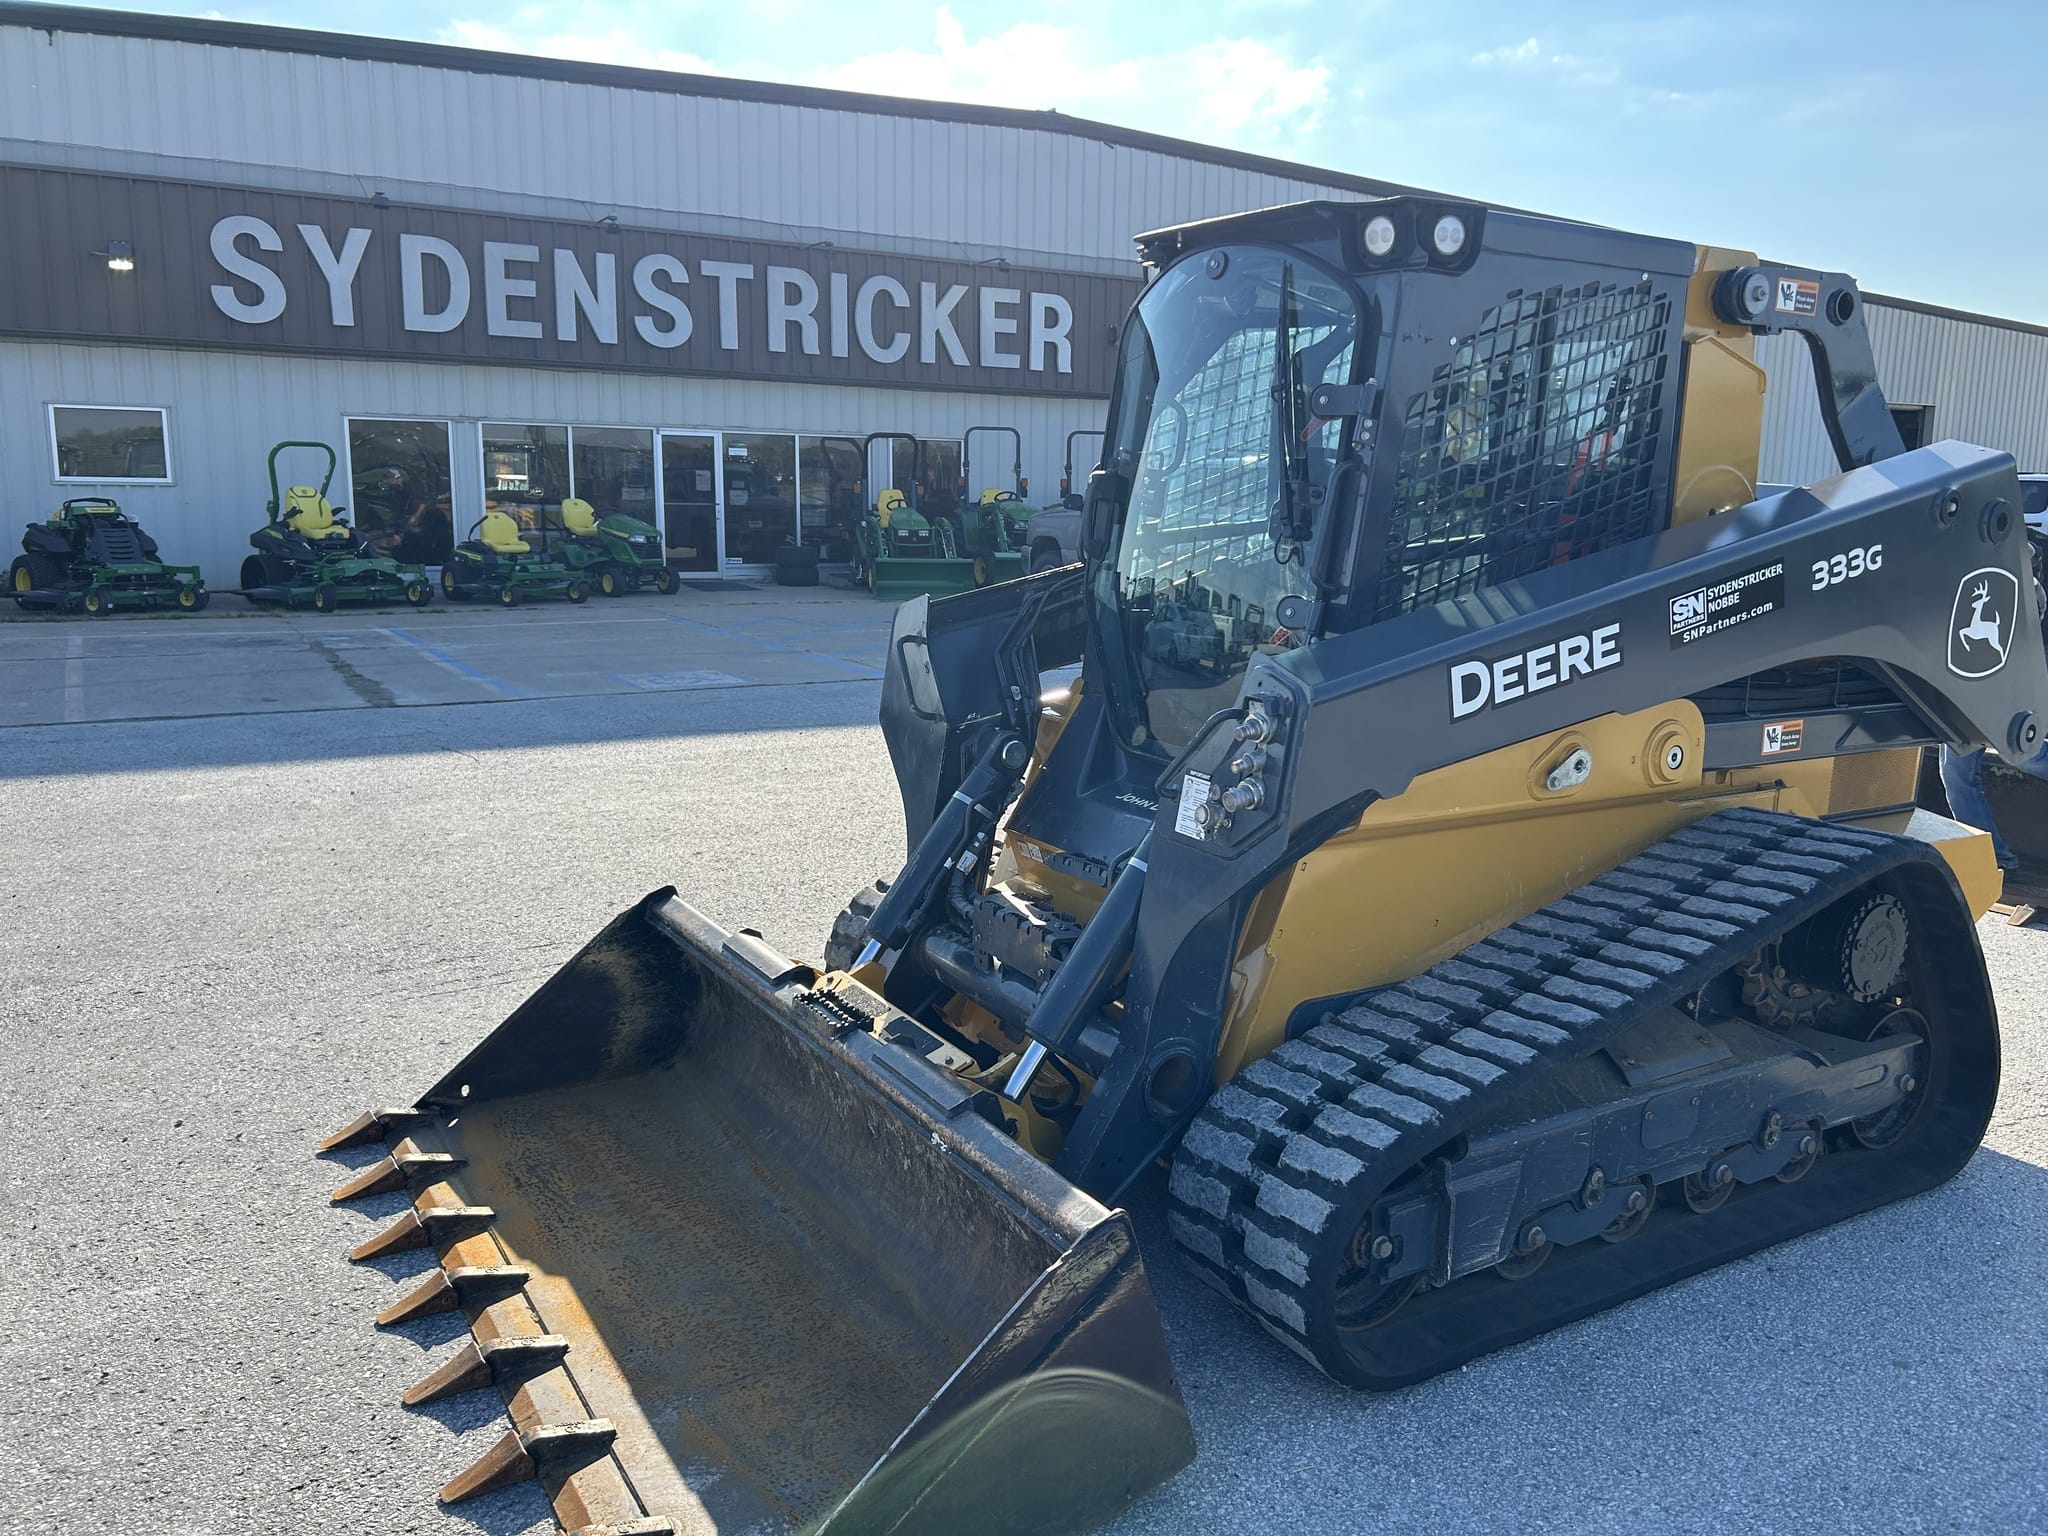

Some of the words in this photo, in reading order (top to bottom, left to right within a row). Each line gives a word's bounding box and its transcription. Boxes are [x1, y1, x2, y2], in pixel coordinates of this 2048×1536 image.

[209, 216, 1074, 373] SYDENSTRICKER
[1707, 563, 1784, 600] SYDENSTRICKER
[1811, 544, 1882, 591] 333G
[1672, 593, 1705, 622] SN
[1708, 592, 1741, 614] NOBBE
[1673, 613, 1705, 631] PARTNERS
[1682, 601, 1774, 643] SNPartners.com
[1451, 622, 1621, 718] DEERE
[1115, 793, 1154, 807] JOHN
